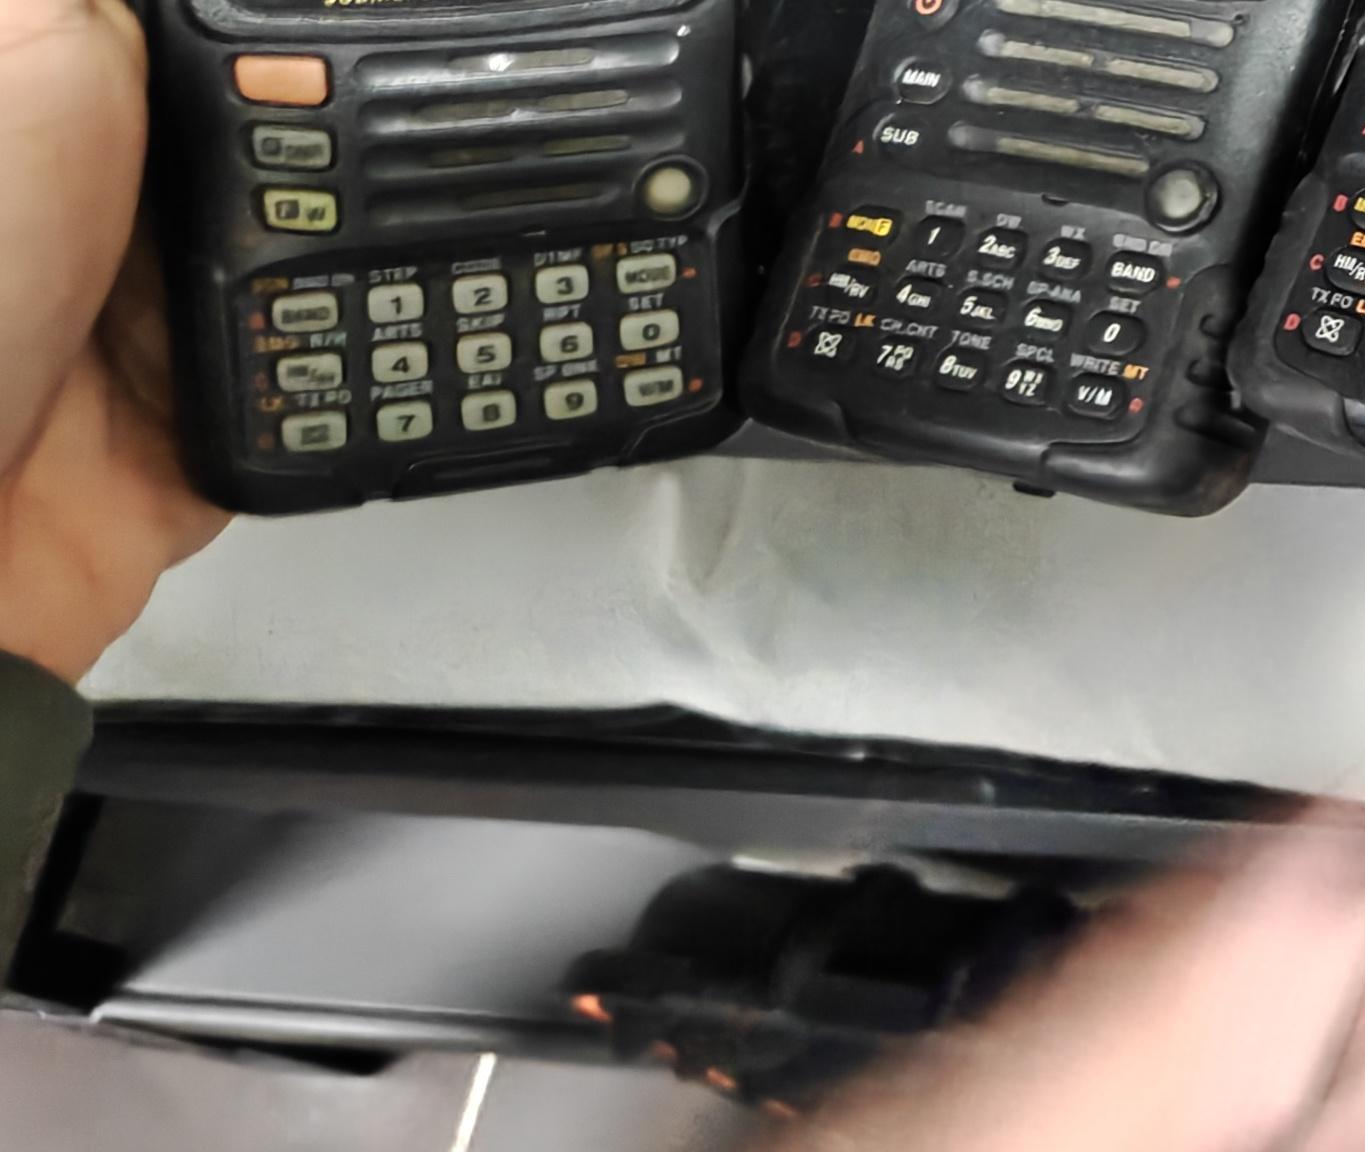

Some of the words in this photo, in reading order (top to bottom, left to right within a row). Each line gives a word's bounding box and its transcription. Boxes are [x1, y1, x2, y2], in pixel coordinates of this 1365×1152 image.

[902, 69, 941, 89] MAIN
[880, 127, 919, 146] SUB
[928, 227, 940, 244] 1
[1111, 262, 1155, 282] BAND
[557, 277, 573, 295] 3
[1311, 287, 1328, 303] TX
[391, 297, 402, 313] 1
[473, 288, 493, 306] 2
[642, 324, 660, 341] 0
[1104, 323, 1121, 343] 0
[561, 336, 578, 352] 6
[476, 346, 496, 363] 5
[392, 357, 410, 372] 4
[1070, 353, 1121, 375] WRITE
[565, 392, 583, 410] 9
[1078, 385, 1112, 406] V/M
[397, 415, 415, 432] 7
